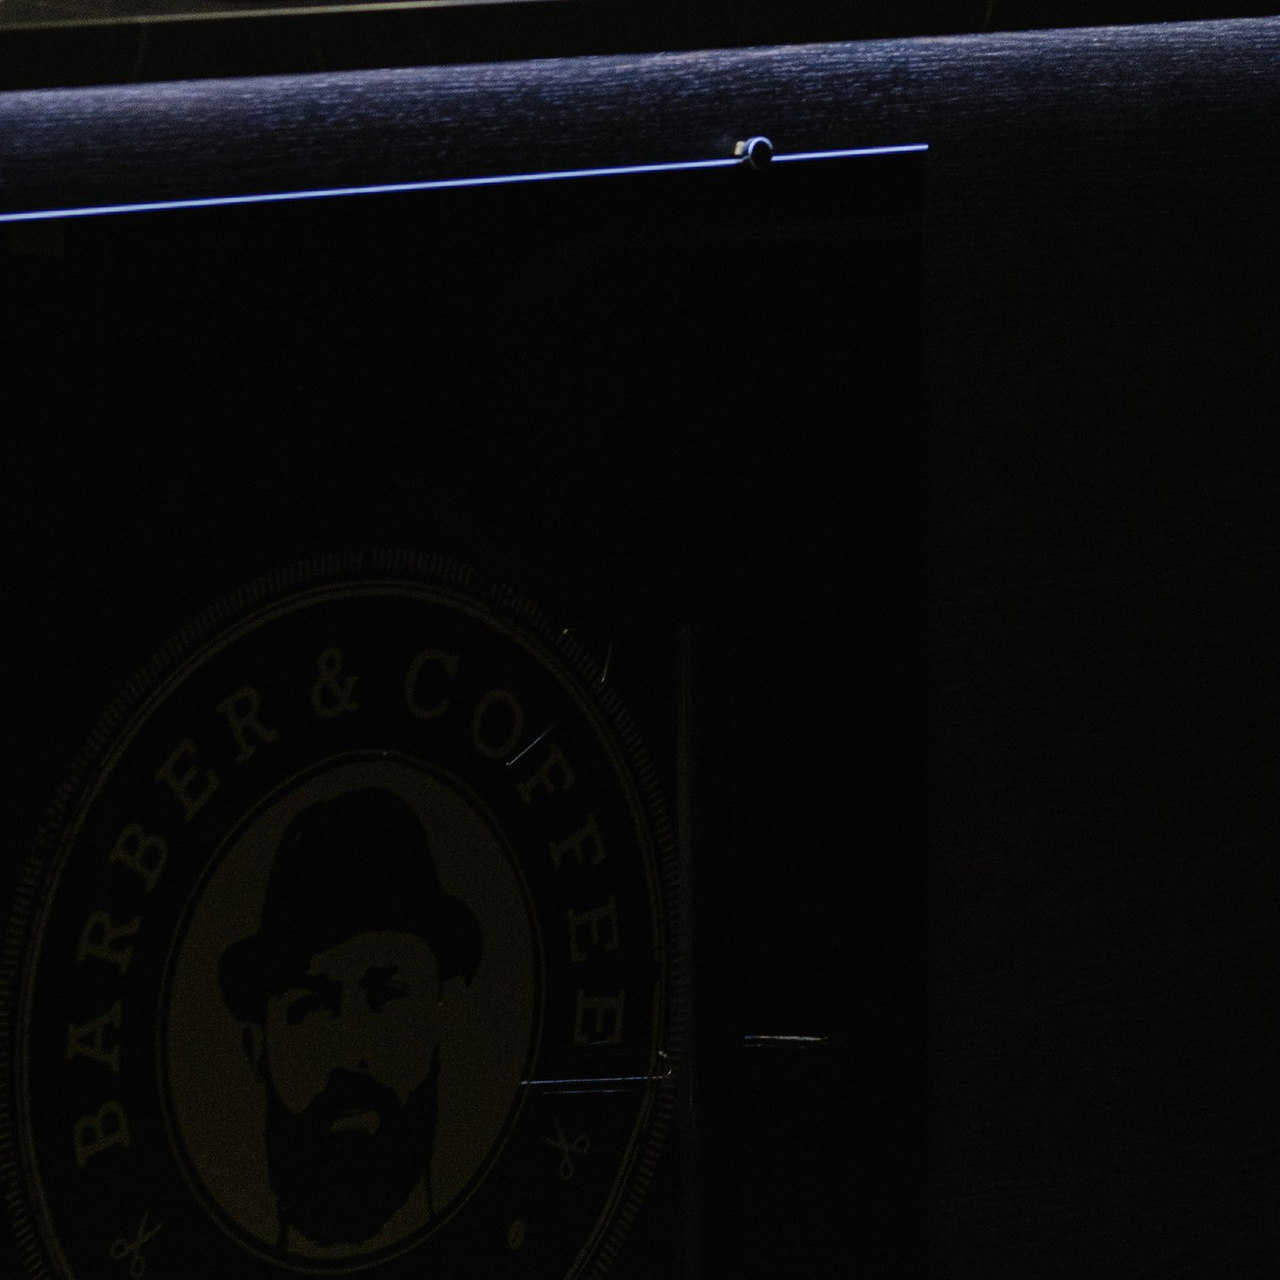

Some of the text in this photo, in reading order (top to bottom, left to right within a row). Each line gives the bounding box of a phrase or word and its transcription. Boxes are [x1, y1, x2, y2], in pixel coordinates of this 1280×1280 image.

[66, 647, 626, 1167] BARBER & COFFEE
